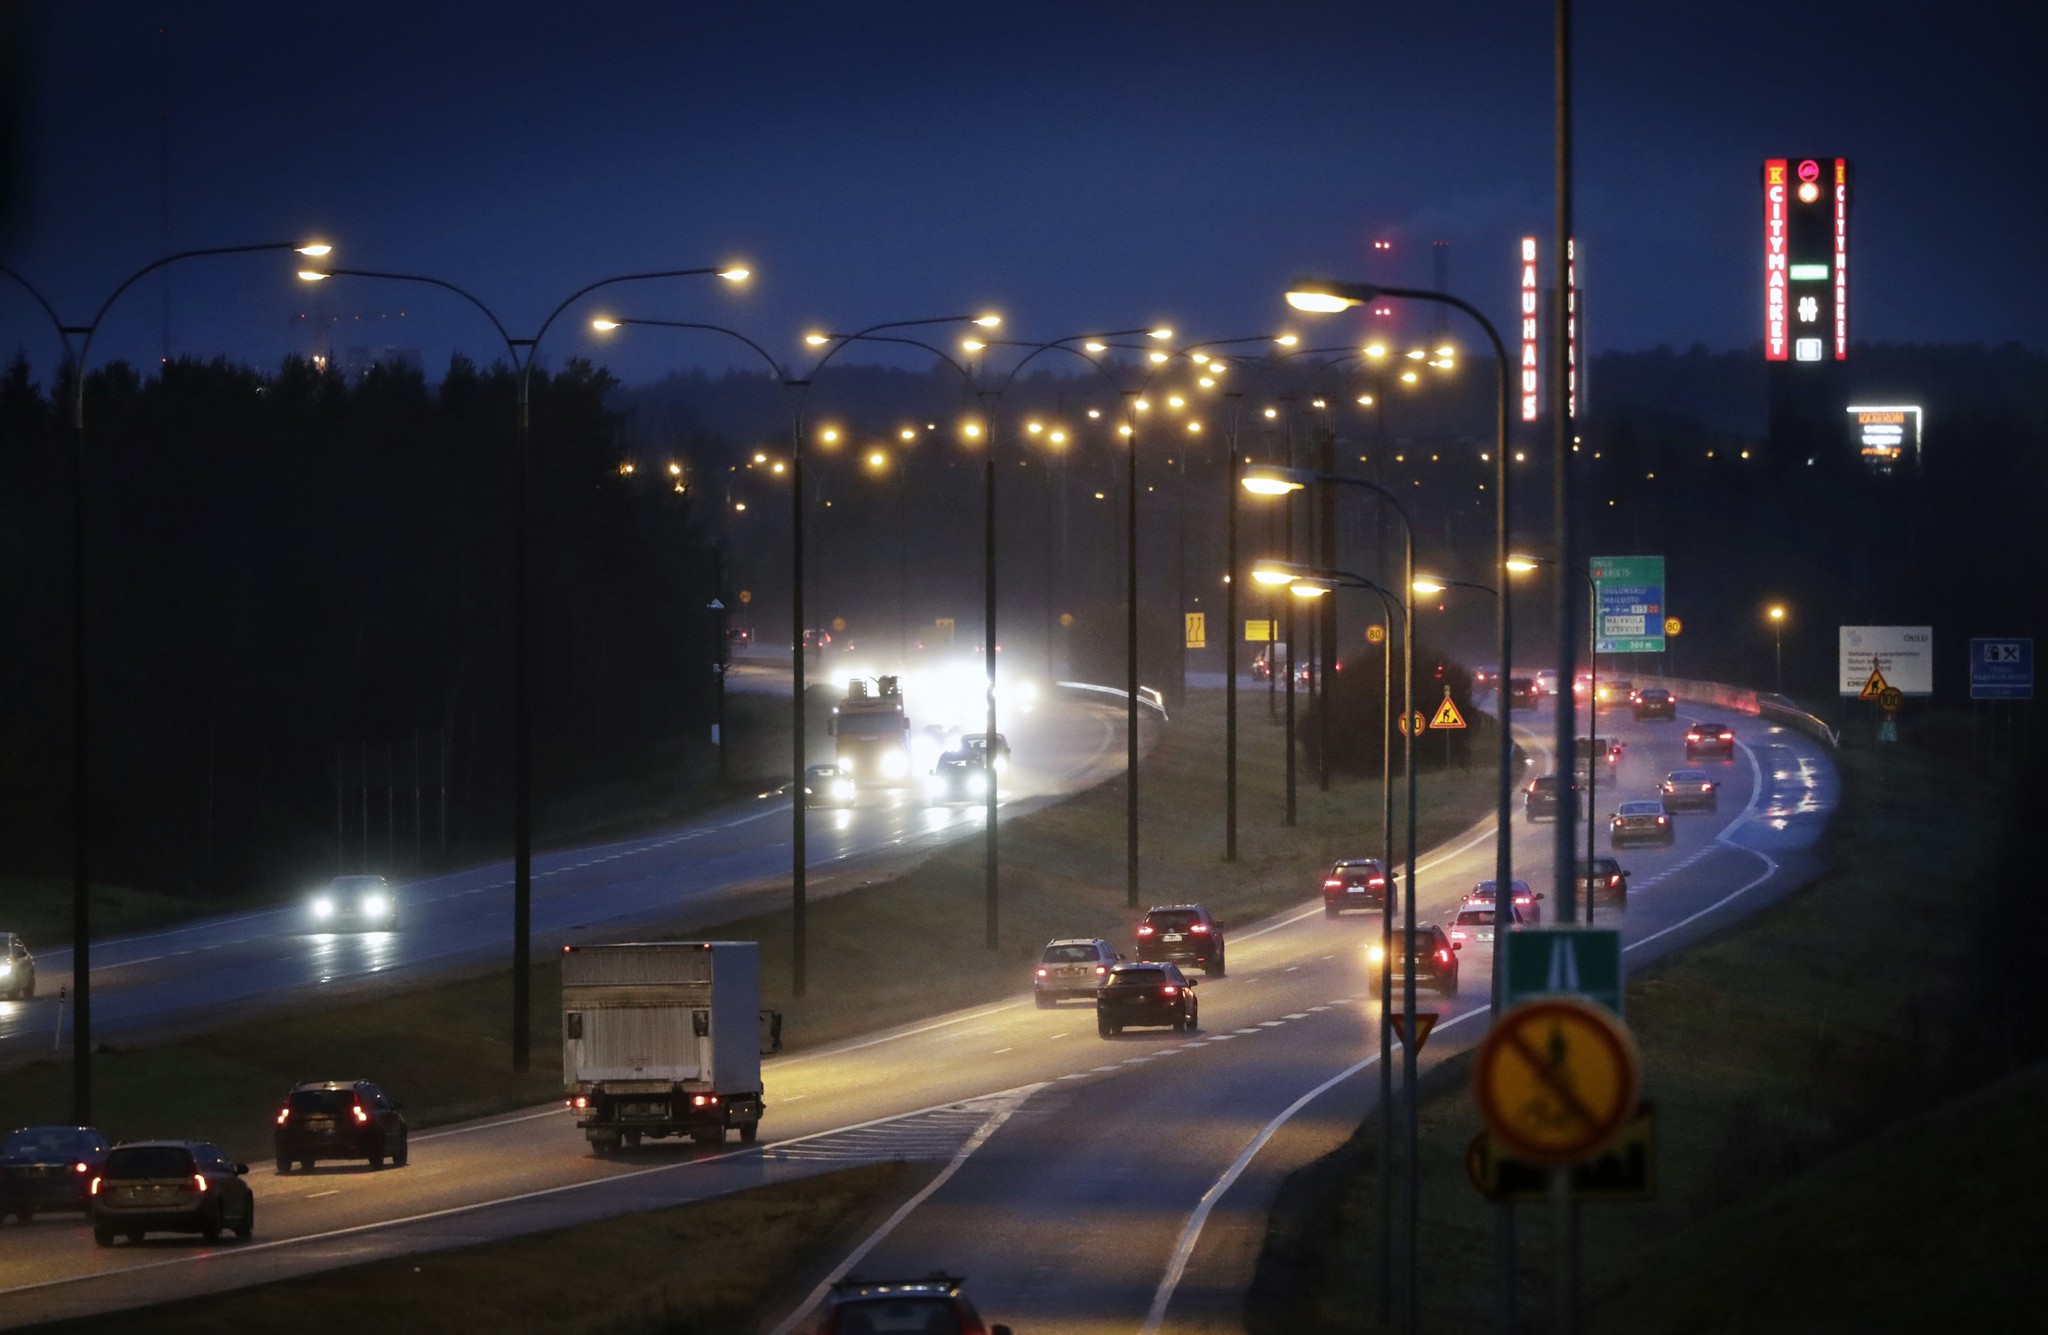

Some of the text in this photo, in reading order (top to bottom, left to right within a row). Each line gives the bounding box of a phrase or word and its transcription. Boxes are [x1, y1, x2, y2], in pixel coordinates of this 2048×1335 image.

[1769, 185, 1785, 355] CITYMARKET
[1836, 185, 1846, 354] CITYMARKET
[1522, 239, 1538, 420] BAUHAUS
[1567, 240, 1576, 419] BAUHAUS
[1369, 629, 1380, 639] 80
[1667, 622, 1678, 631] 80
[1402, 717, 1421, 730] 10
[1882, 694, 1899, 706] 100
